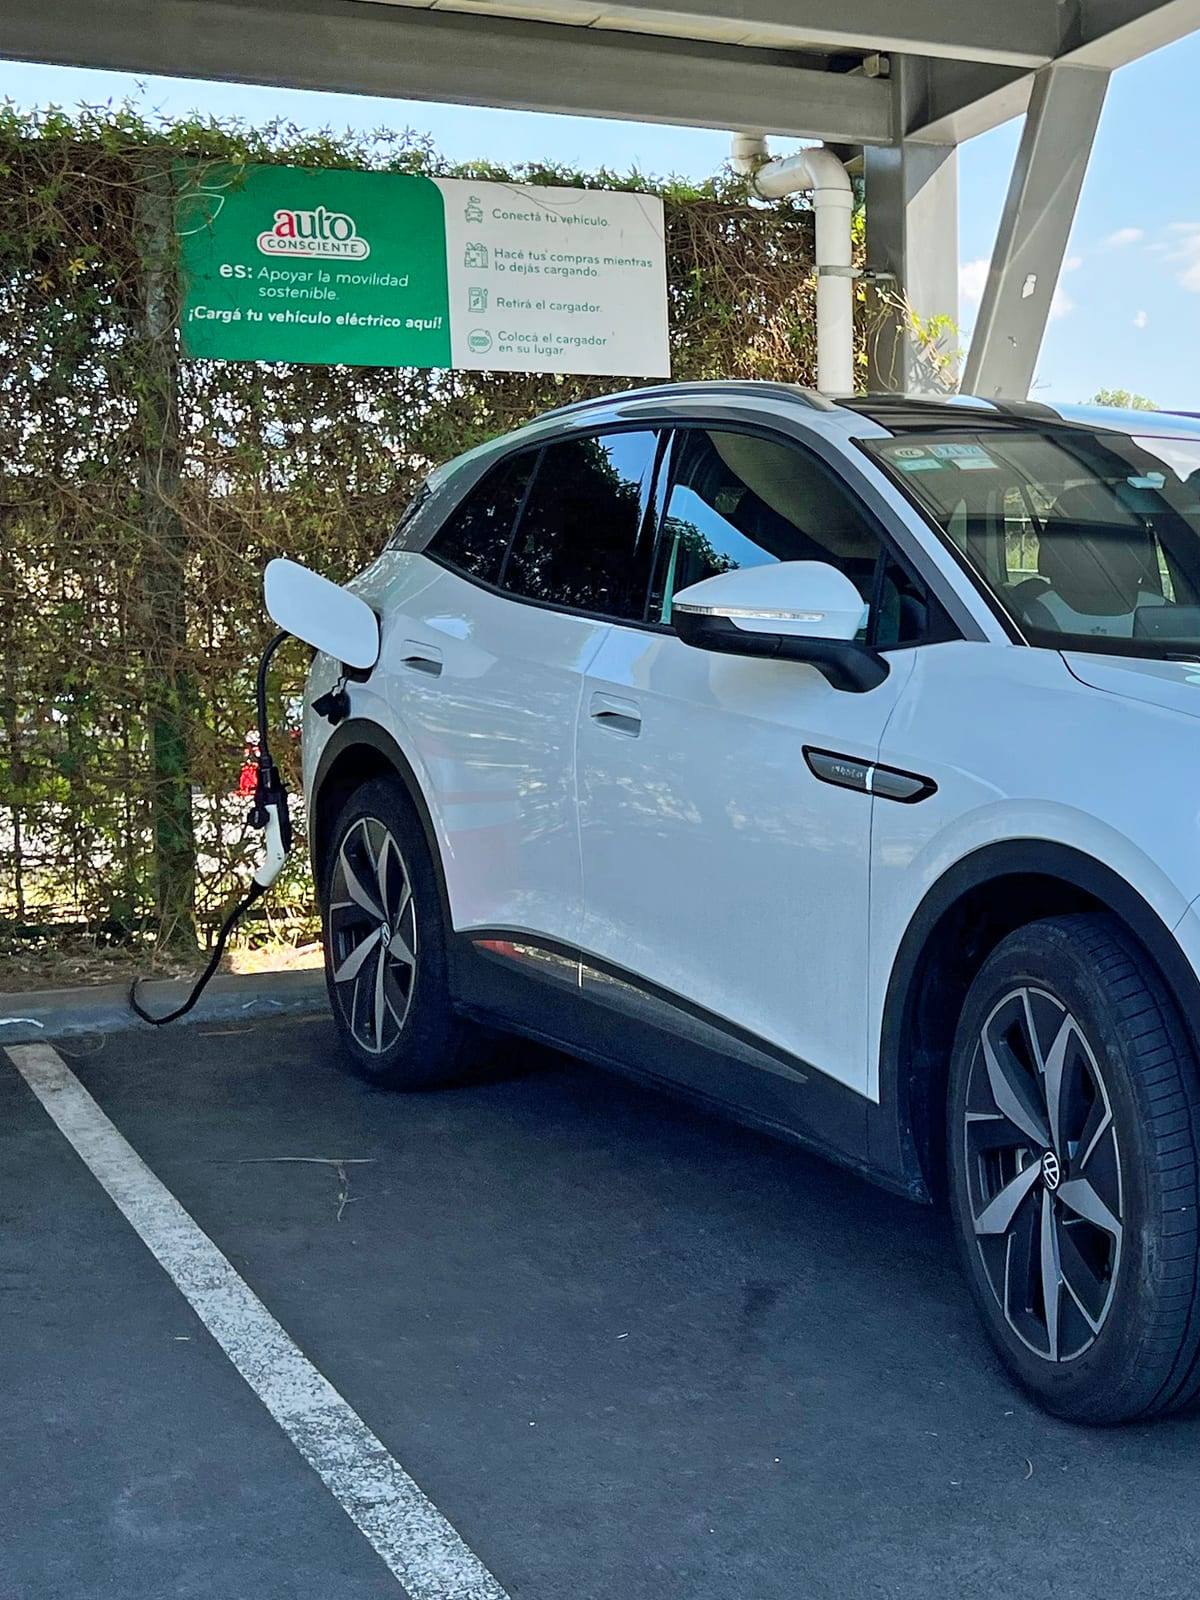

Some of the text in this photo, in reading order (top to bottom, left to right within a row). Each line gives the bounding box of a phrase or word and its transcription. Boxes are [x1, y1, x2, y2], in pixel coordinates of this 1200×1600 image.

[491, 208, 542, 222] Conectá
[545, 212, 558, 224] tu
[275, 208, 354, 241] auto
[267, 238, 359, 254] CONSCIENTE
[494, 247, 653, 269] Hacé tus compras mientras
[219, 263, 409, 288] es: Apoyar la movilidad
[494, 260, 506, 272] lo
[509, 262, 540, 276] dejás
[258, 286, 340, 301] sostenible.
[496, 297, 532, 310] Retirá
[535, 299, 546, 310] el
[188, 305, 443, 332] ¡Cargá tu vehículo eléctrico aquí!
[497, 330, 608, 348] Colocá el cargador
[498, 343, 513, 353] en
[517, 344, 530, 354] su
